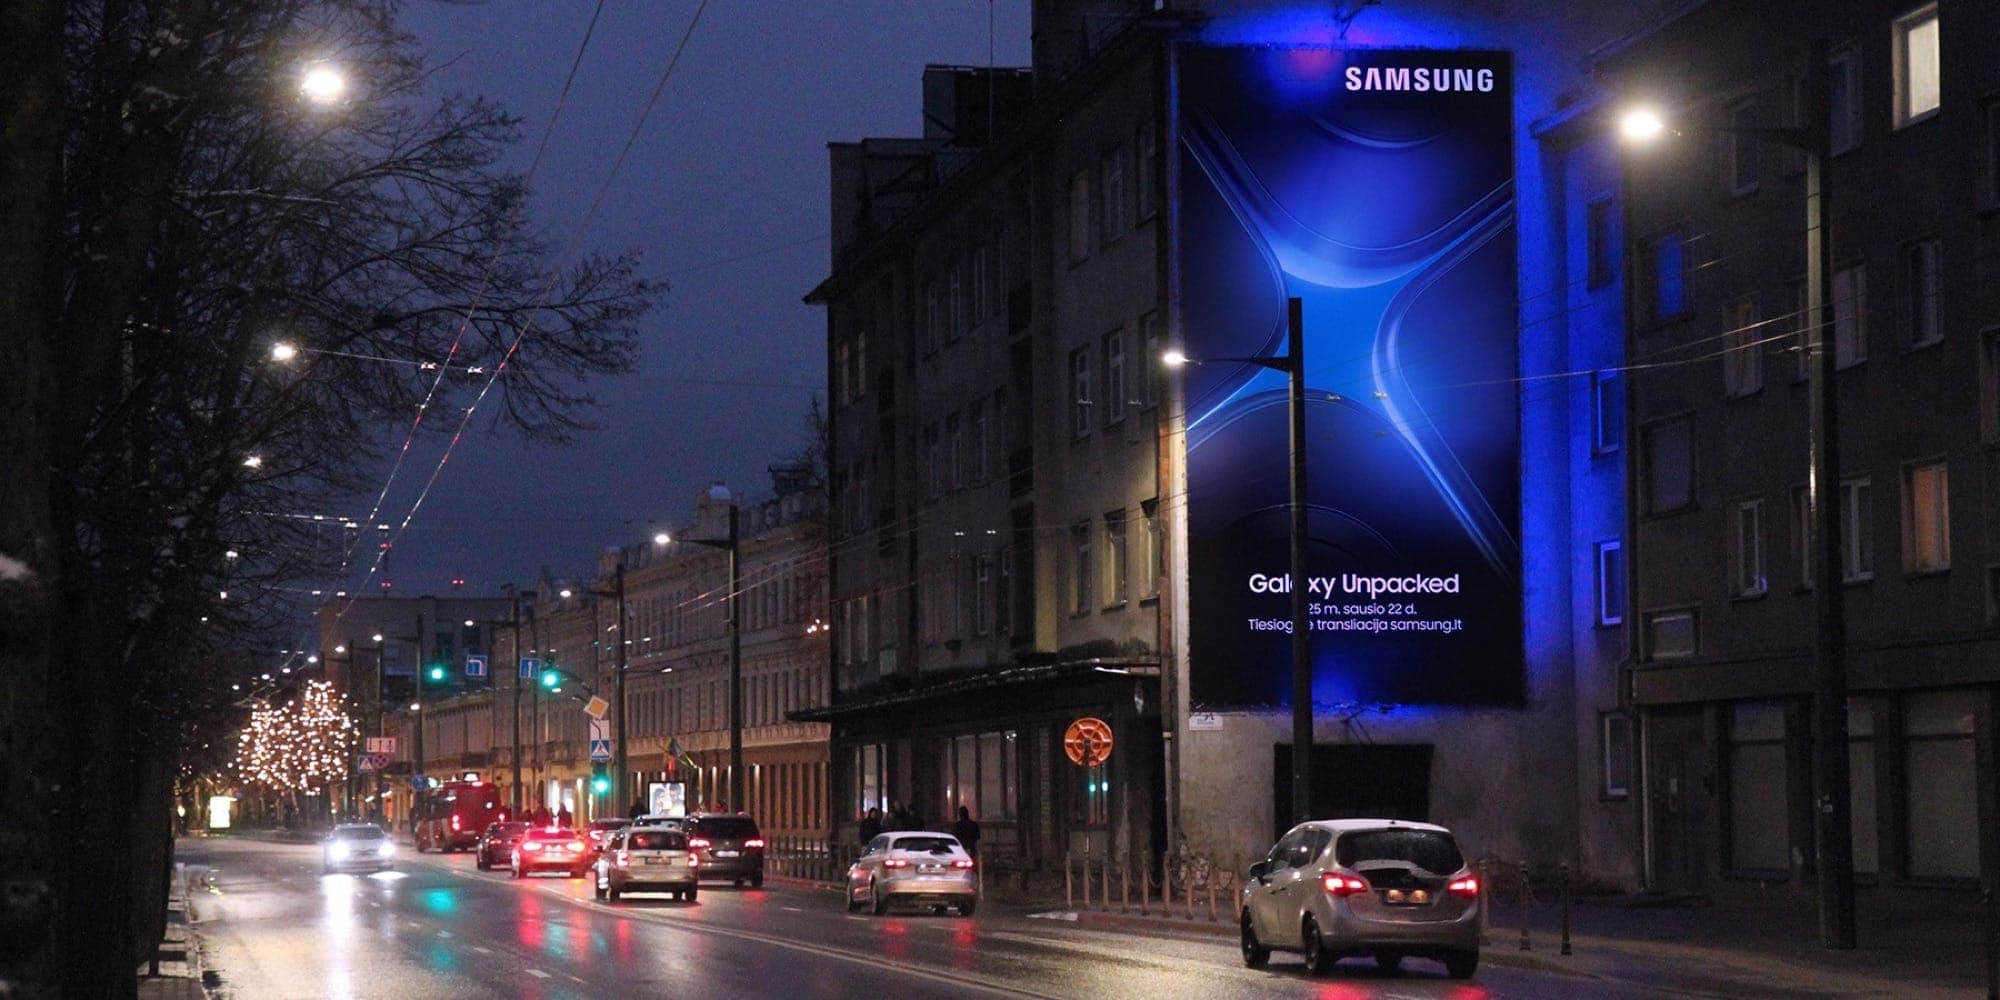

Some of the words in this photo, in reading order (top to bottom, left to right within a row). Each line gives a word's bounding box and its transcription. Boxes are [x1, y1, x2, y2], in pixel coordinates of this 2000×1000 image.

[1345, 67, 1494, 92] SAMSUNG
[1249, 573, 1336, 599] Galxy
[1342, 573, 1459, 599] Unpacked
[1324, 604, 1341, 615] m.
[1343, 603, 1385, 615] sausio
[1388, 603, 1402, 615] 22
[1405, 603, 1417, 615] d.
[1317, 618, 1388, 634] transliacija
[1390, 619, 1462, 634] samsung.lt
